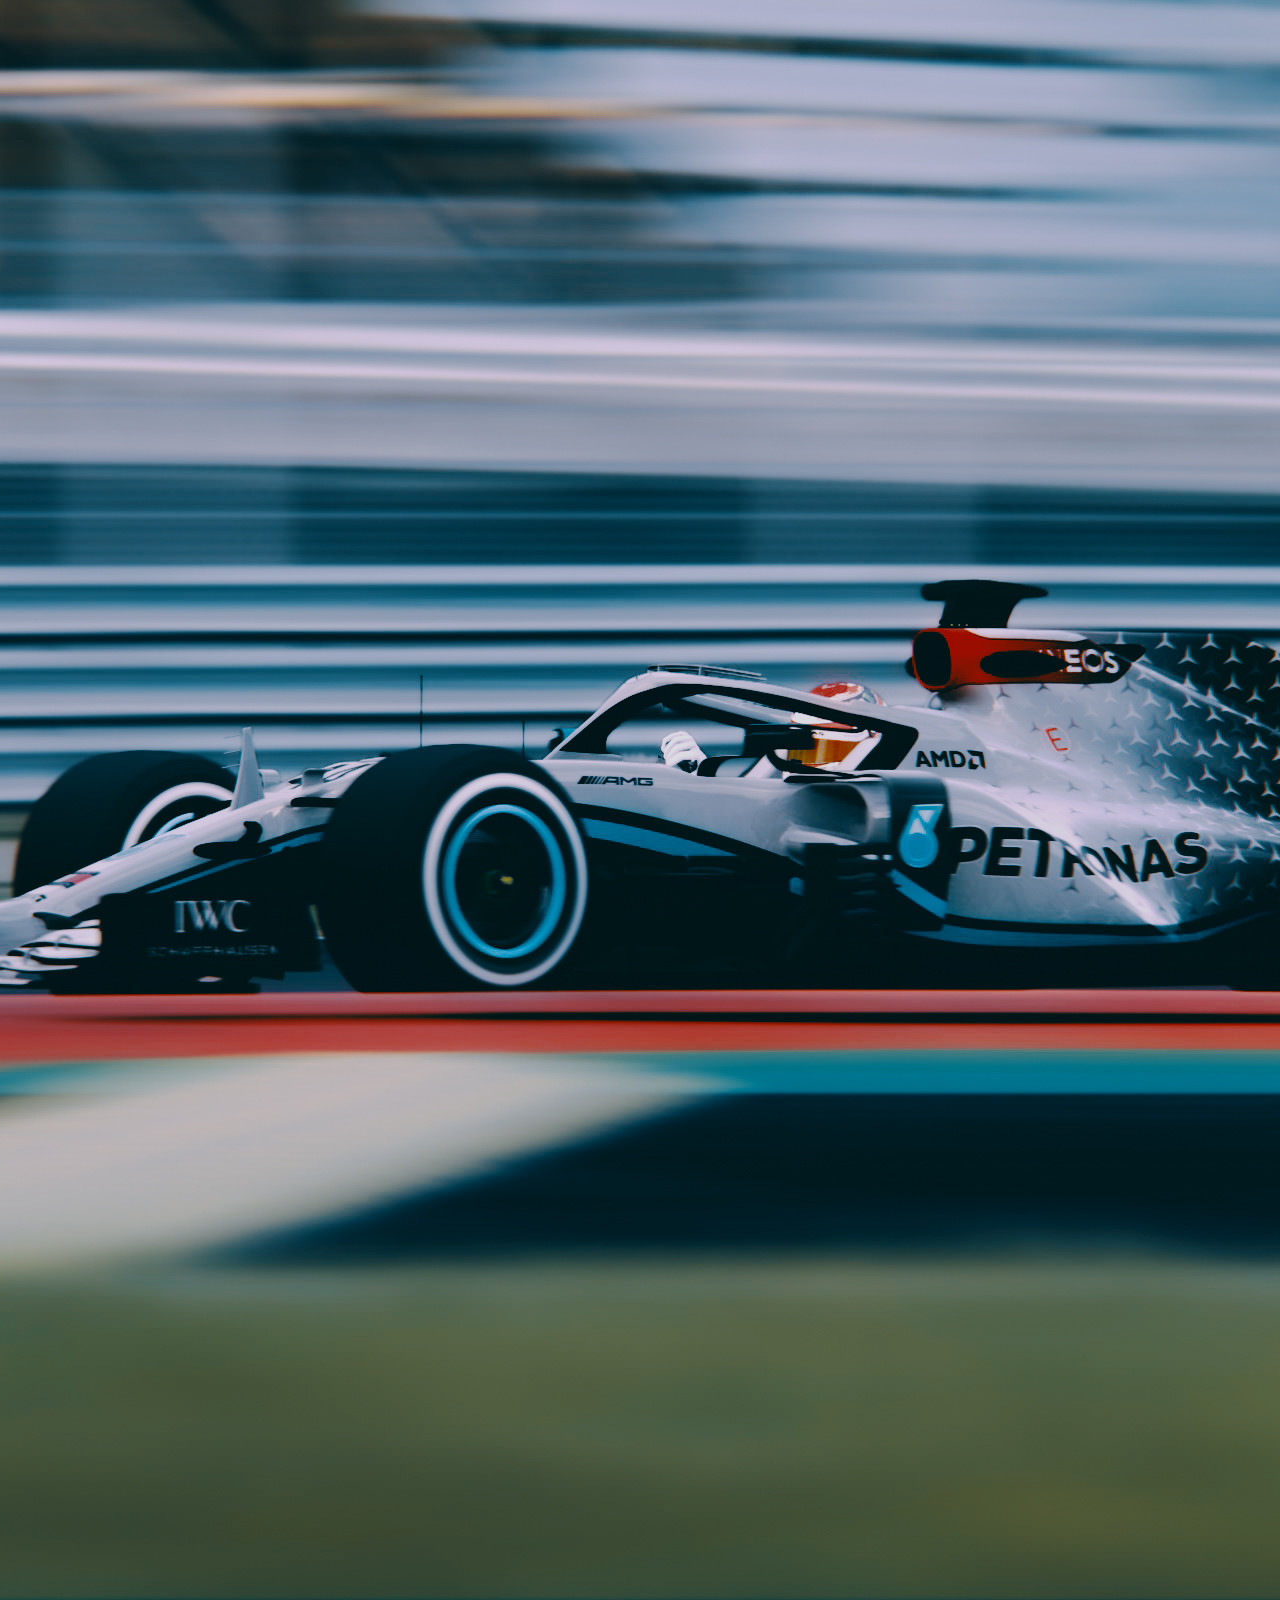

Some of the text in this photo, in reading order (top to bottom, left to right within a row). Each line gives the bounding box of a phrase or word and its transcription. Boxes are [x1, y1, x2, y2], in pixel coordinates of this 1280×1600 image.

[1045, 727, 1068, 751] E
[916, 750, 966, 768] AMD
[602, 776, 654, 786] AMG
[949, 826, 1208, 882] PETRONAS
[174, 900, 251, 933] IWC
